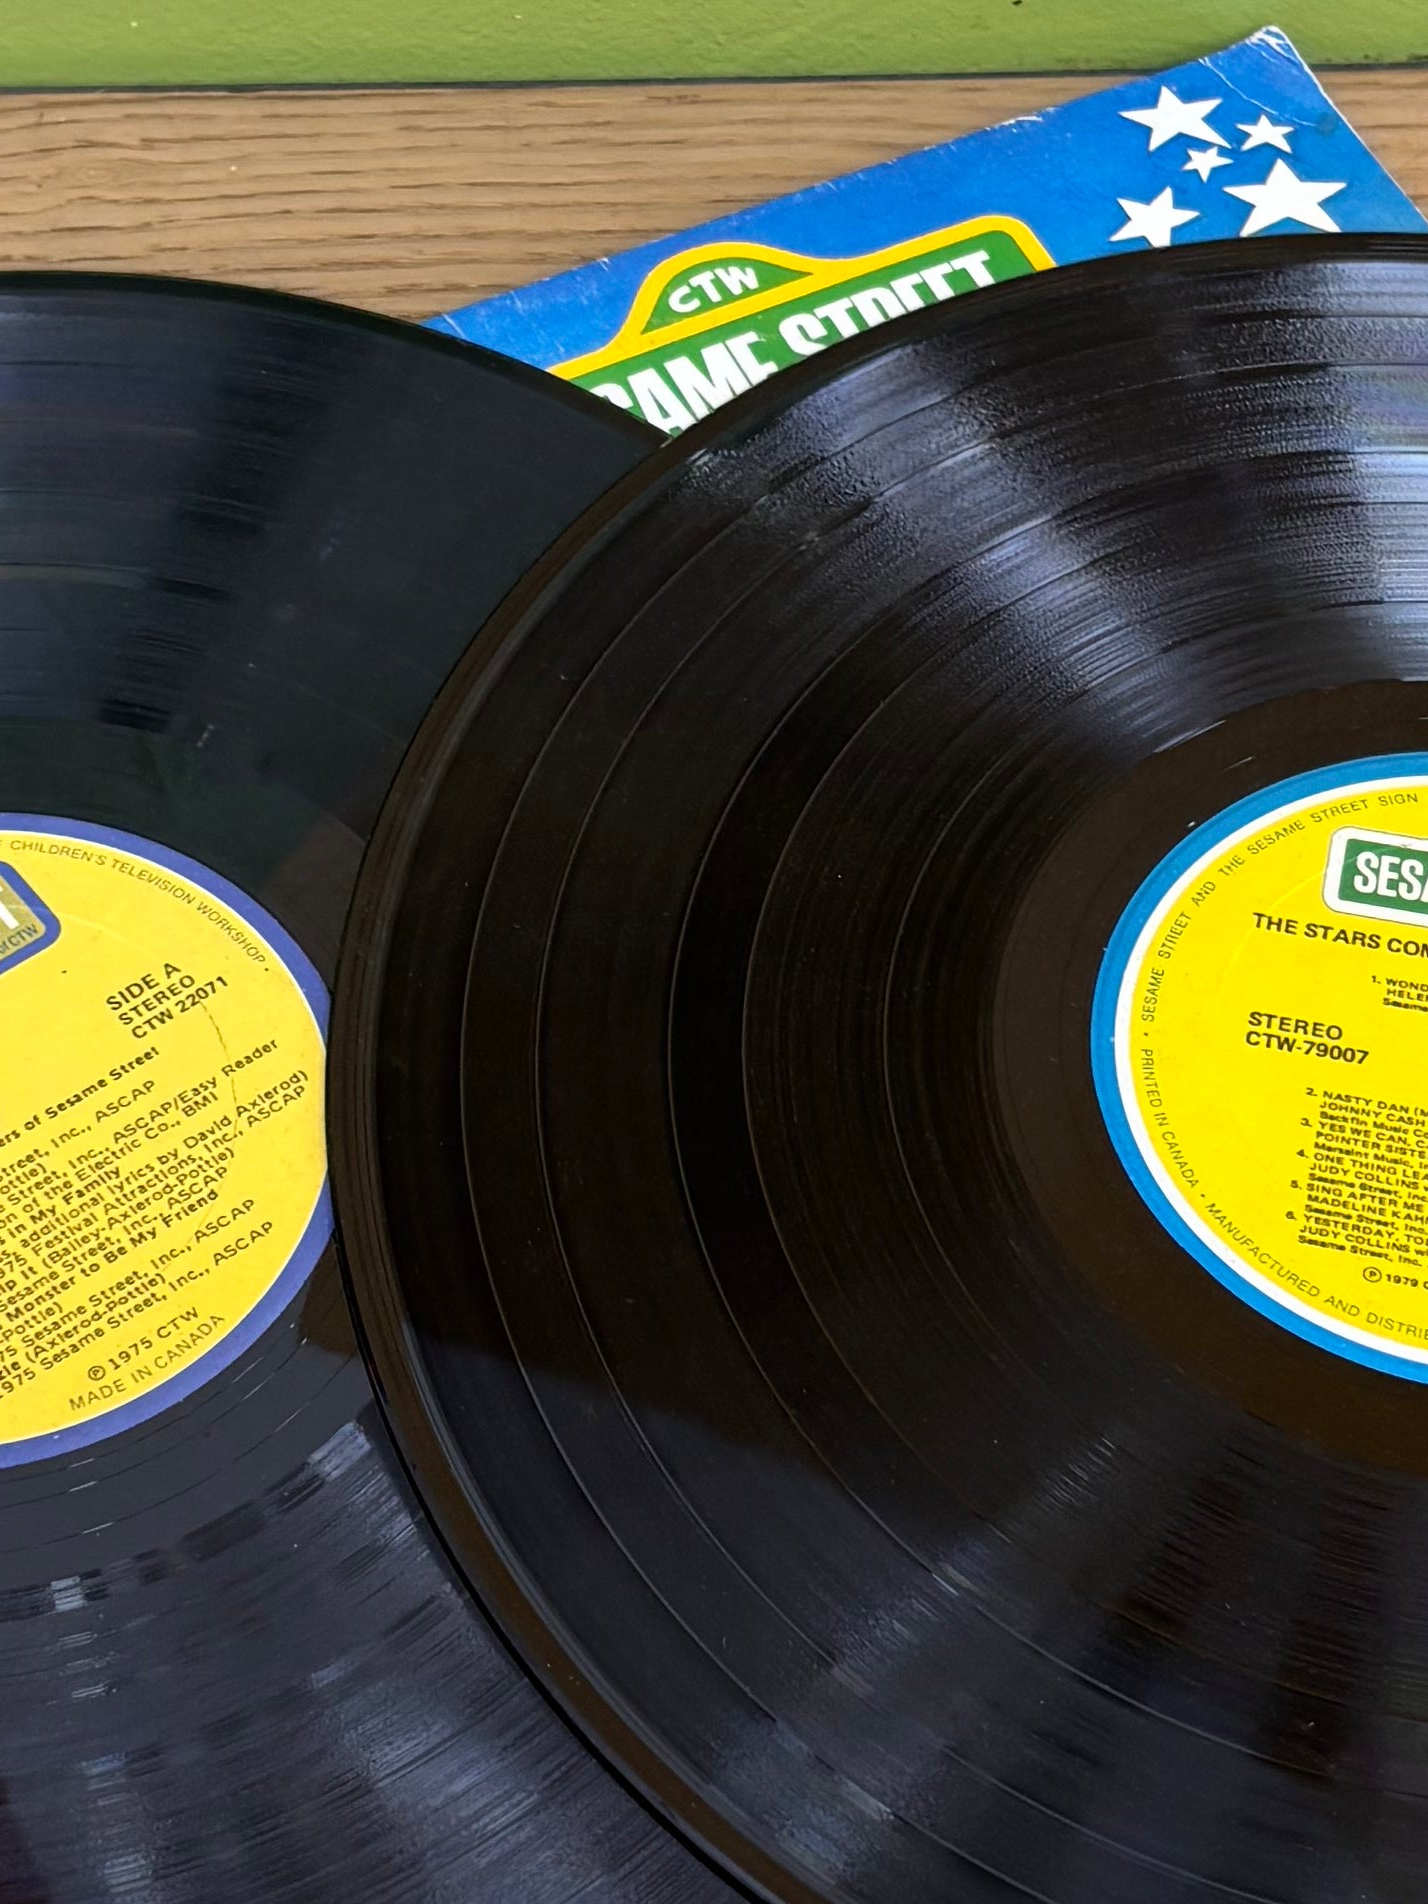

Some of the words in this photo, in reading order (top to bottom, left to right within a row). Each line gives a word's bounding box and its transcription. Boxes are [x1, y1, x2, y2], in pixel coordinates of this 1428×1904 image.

[668, 266, 759, 313] CTW
[10, 839, 107, 866] CHILDREN'S
[110, 859, 195, 905] TELEVISION
[196, 902, 266, 964] WORKSHOP
[1141, 968, 1165, 1022] SESAME
[1191, 880, 1216, 907] AND
[1218, 854, 1245, 877] THE
[1247, 820, 1305, 855] SESAME
[1310, 800, 1369, 823] STREET
[1378, 793, 1419, 807] SIGN
[9, 924, 39, 946] CTW
[1253, 912, 1298, 935] THE
[1304, 923, 1380, 949] STARS
[106, 973, 160, 1011] SIDE
[164, 963, 181, 978] A
[119, 975, 195, 1025] STEREO
[1371, 975, 1380, 984] 1.
[131, 1009, 174, 1039] CTW
[175, 977, 228, 1013] 22071
[1248, 1011, 1343, 1040] STEREO
[1246, 1031, 1369, 1064] CTW-79007
[24, 1115, 41, 1132] of
[44, 1078, 107, 1119] Sesame
[109, 1046, 160, 1080] Street
[1141, 1049, 1162, 1108] PRINTED
[1306, 1087, 1317, 1096] 2.
[1323, 1090, 1372, 1106] NASTY
[1377, 1101, 1409, 1114] DAN
[1155, 1112, 1170, 1127] IN
[1319, 1121, 1346, 1133] YES
[1350, 1127, 1372, 1138] WE
[1320, 1101, 1382, 1118] JOHNNY
[1386, 1114, 1425, 1127] CASH
[1162, 1131, 1199, 1188] CANADA
[1316, 1131, 1381, 1150] POINTER
[20, 1191, 105, 1248] additional
[107, 1163, 155, 1195] lyrics
[156, 1148, 178, 1166] by
[183, 1115, 232, 1149] David
[1314, 1153, 1344, 1165] ONE
[1350, 1159, 1397, 1176] THING
[10, 1222, 27, 1238] in
[29, 1206, 57, 1225] My
[62, 1167, 120, 1205] Family
[5, 1277, 76, 1322] Monster
[80, 1263, 100, 1277] to
[103, 1245, 129, 1264] Be
[129, 1227, 158, 1248] My
[161, 1189, 219, 1227] Friend
[20, 1266, 38, 1280] It
[1206, 1202, 1321, 1297] MANUFACTURED
[1324, 1296, 1360, 1316] AND
[1386, 1274, 1418, 1287] 1979
[107, 1336, 153, 1370] 1975
[156, 1307, 199, 1339] CTW
[69, 1379, 126, 1411] MADE
[130, 1365, 153, 1383] IN
[154, 1315, 225, 1369] CANADA
